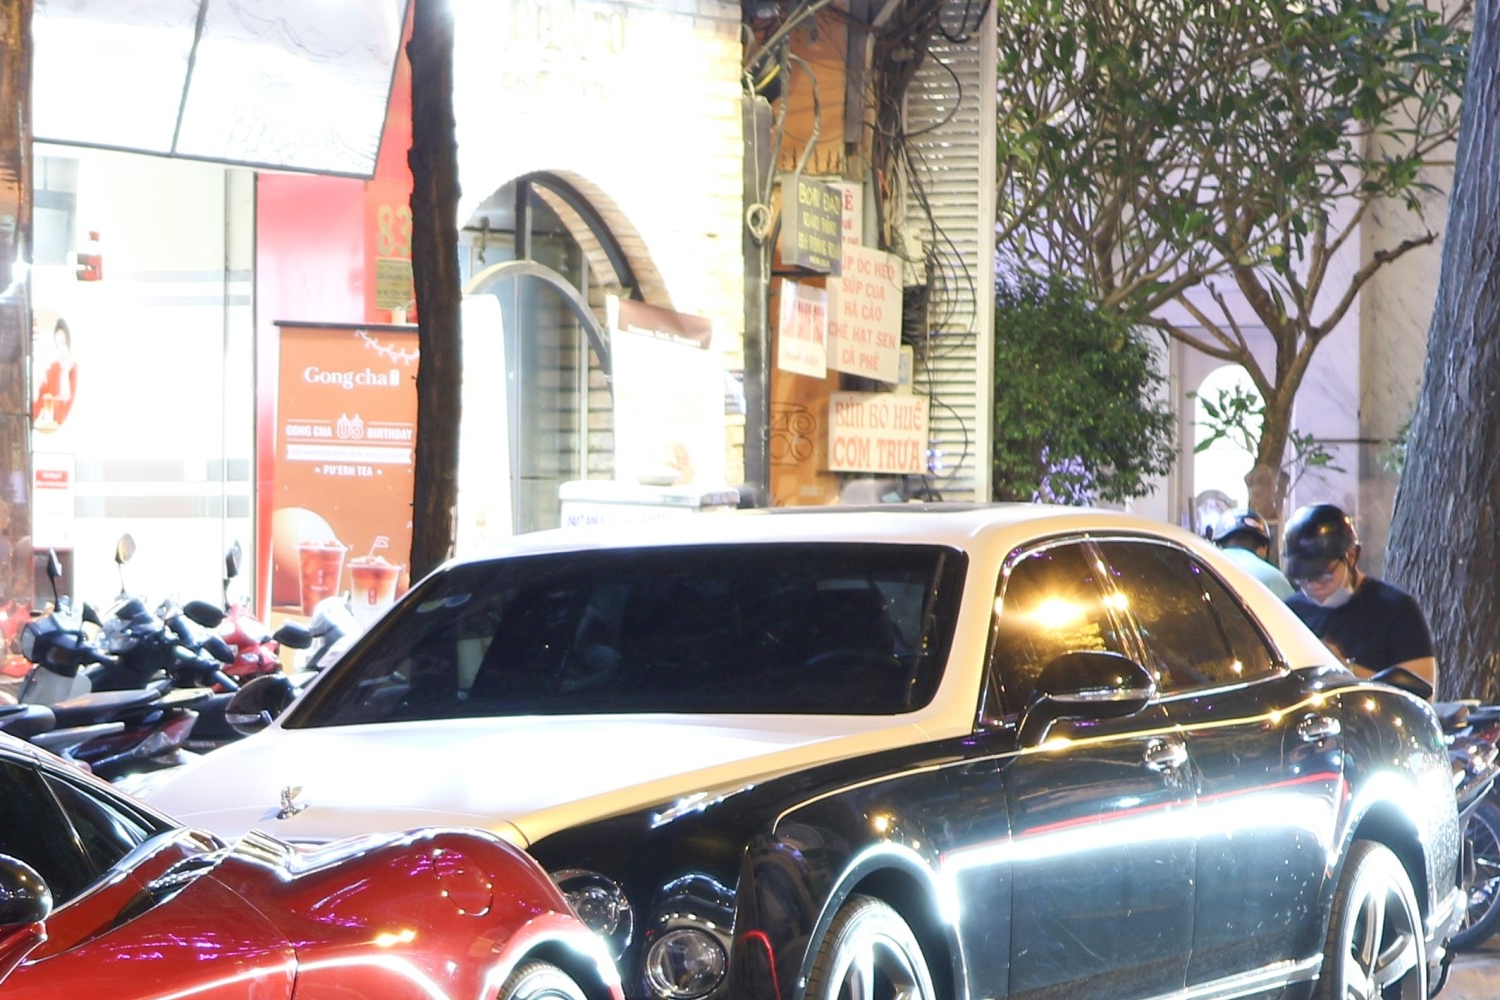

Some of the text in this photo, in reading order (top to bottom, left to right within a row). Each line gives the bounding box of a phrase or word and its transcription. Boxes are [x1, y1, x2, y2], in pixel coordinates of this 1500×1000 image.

[865, 282, 886, 300] CUA
[876, 331, 896, 350] SEN
[304, 366, 388, 389] Gong cha
[869, 399, 889, 429] BÒ
[286, 424, 311, 437] GONG
[313, 425, 332, 438] CHA
[367, 427, 413, 440] BIRTHDAY
[357, 466, 374, 477] TEA
